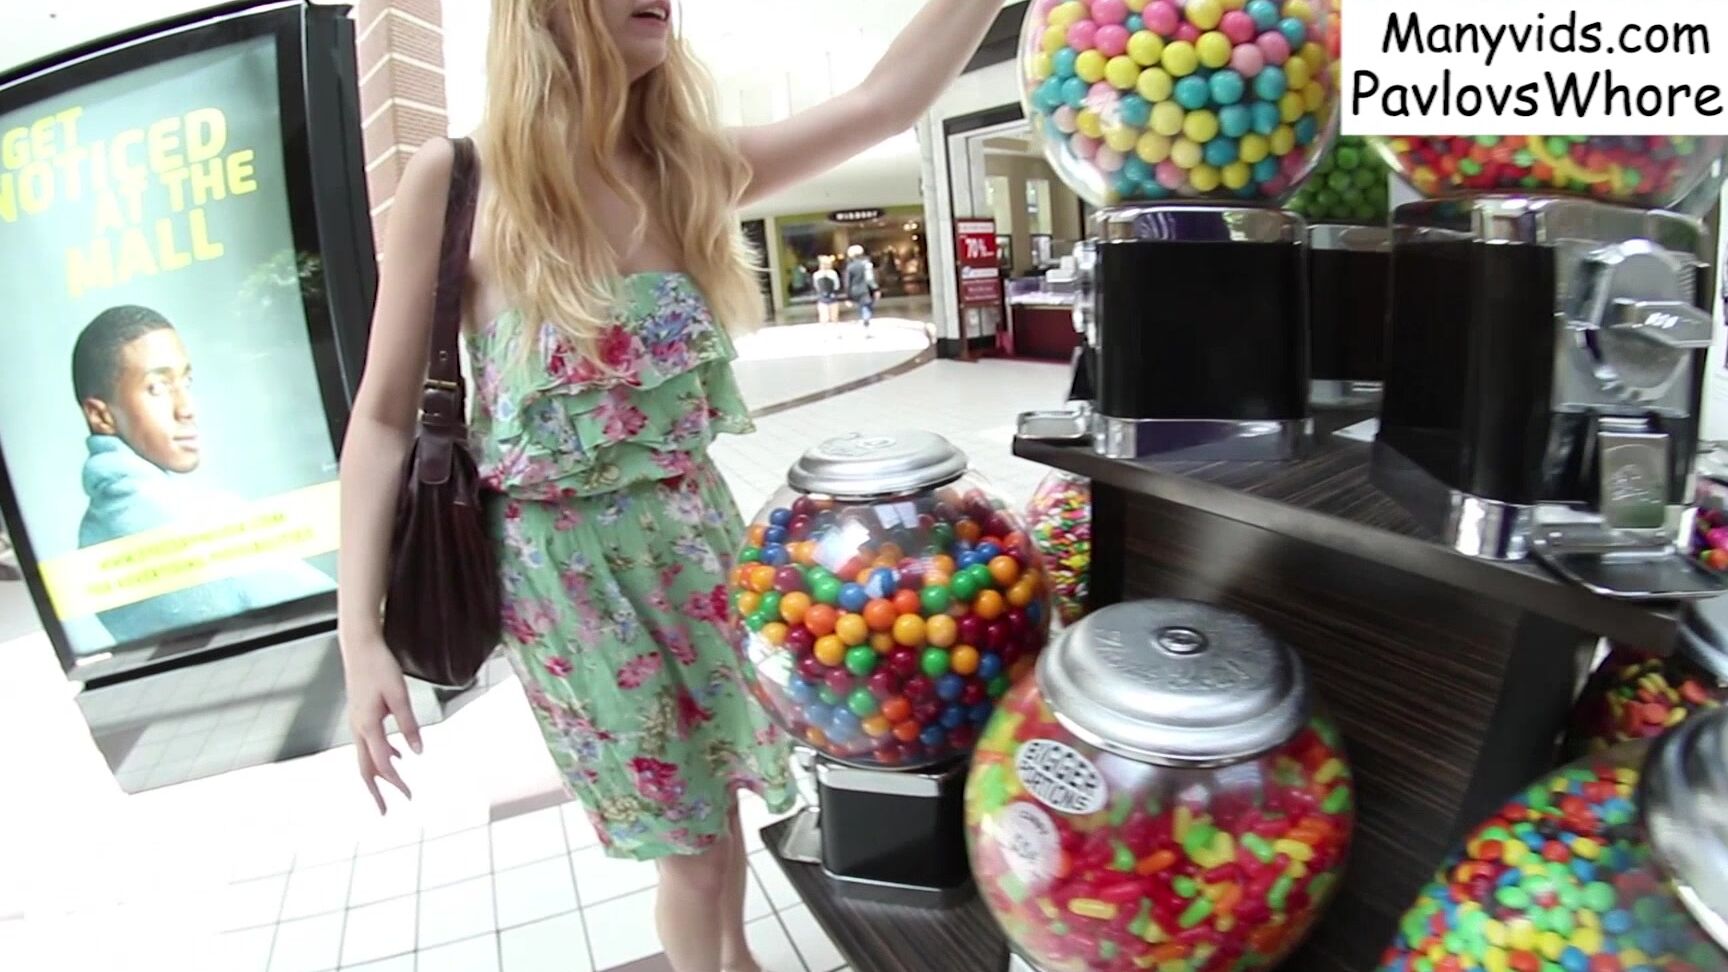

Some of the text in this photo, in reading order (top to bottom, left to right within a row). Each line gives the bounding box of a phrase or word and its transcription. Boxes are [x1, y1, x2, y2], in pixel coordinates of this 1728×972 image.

[0, 107, 227, 222] NOTICED
[2, 106, 83, 170] GET
[94, 149, 257, 234] AT THE
[65, 207, 224, 298] MALL
